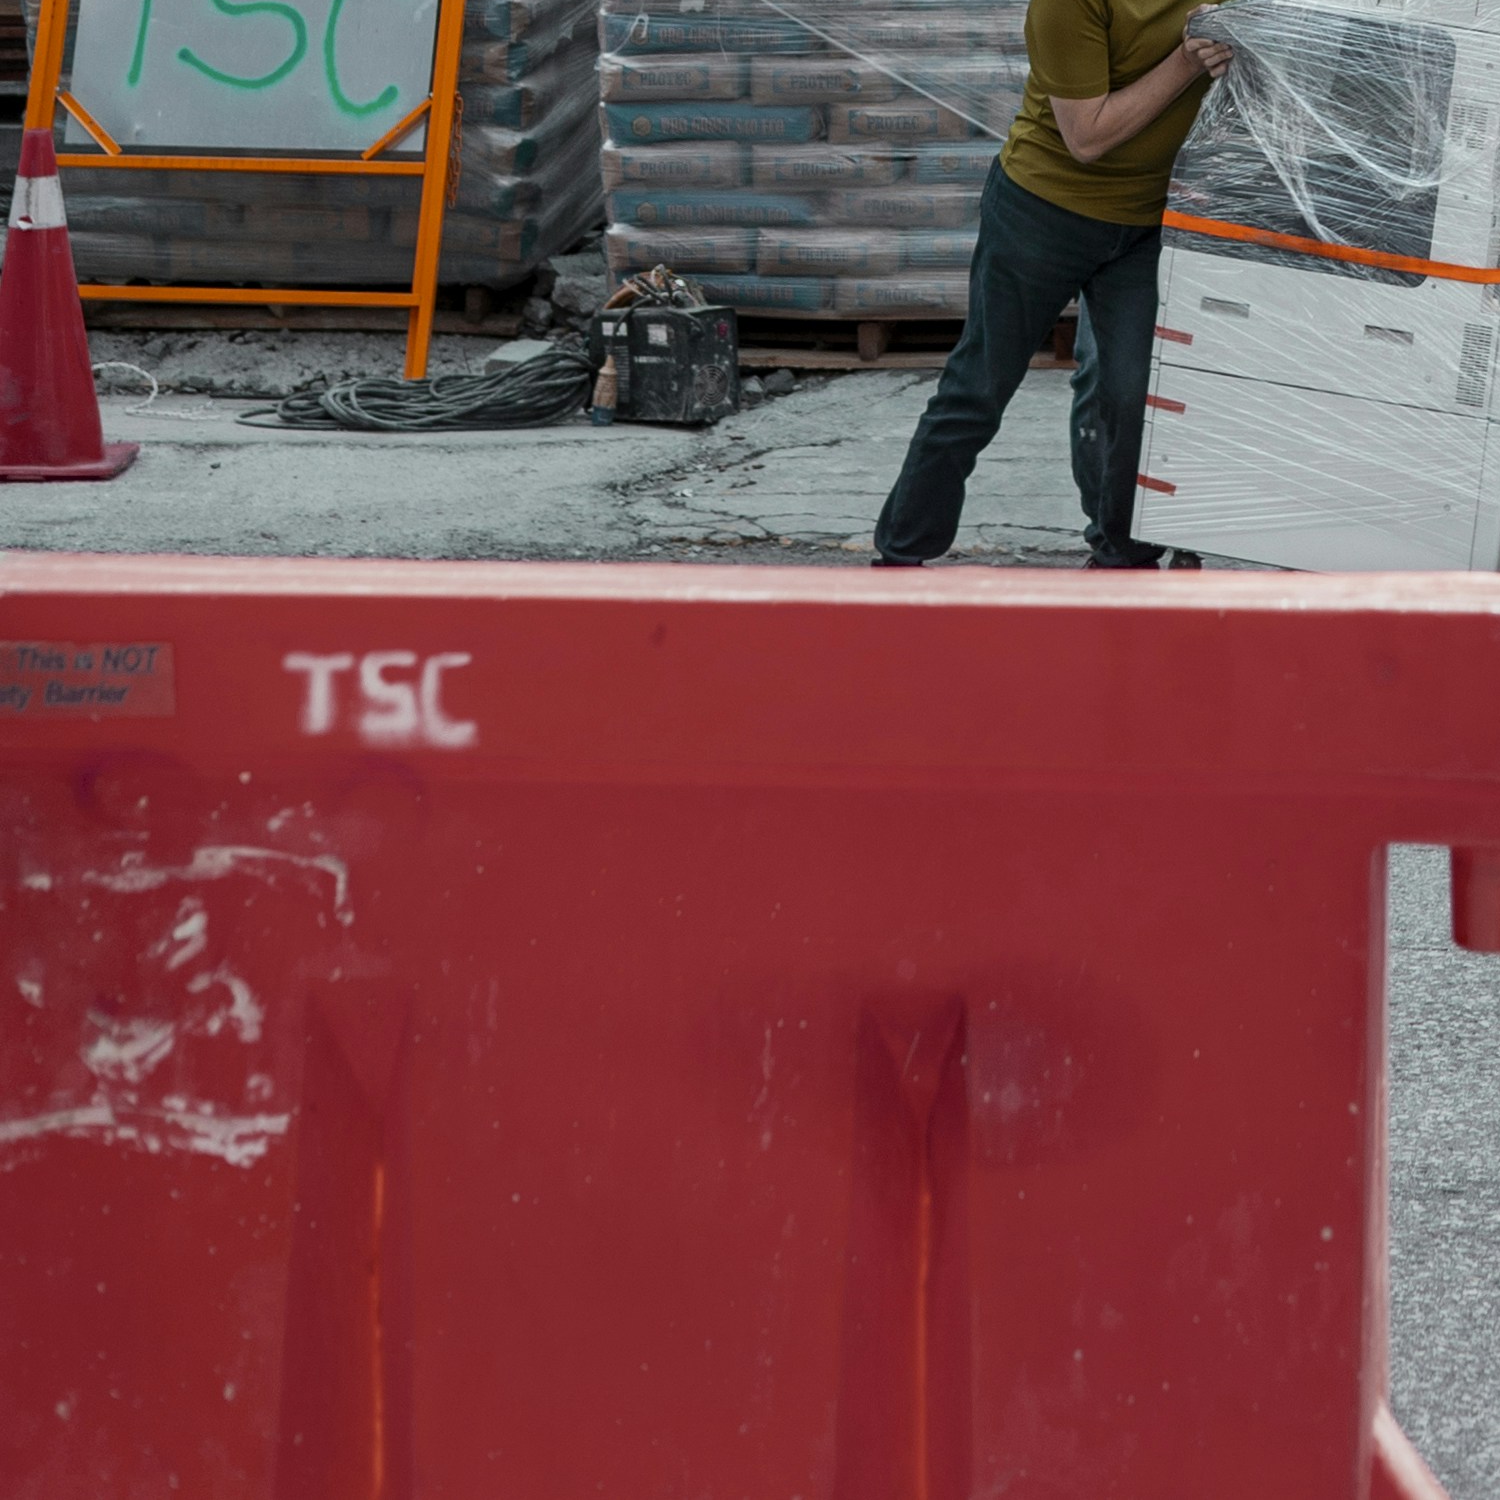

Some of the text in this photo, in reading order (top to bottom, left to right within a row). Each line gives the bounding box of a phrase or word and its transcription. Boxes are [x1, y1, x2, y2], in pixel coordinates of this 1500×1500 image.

[639, 71, 692, 86] PROTEC
[17, 646, 160, 674] This is NOT
[282, 650, 478, 750] TSC
